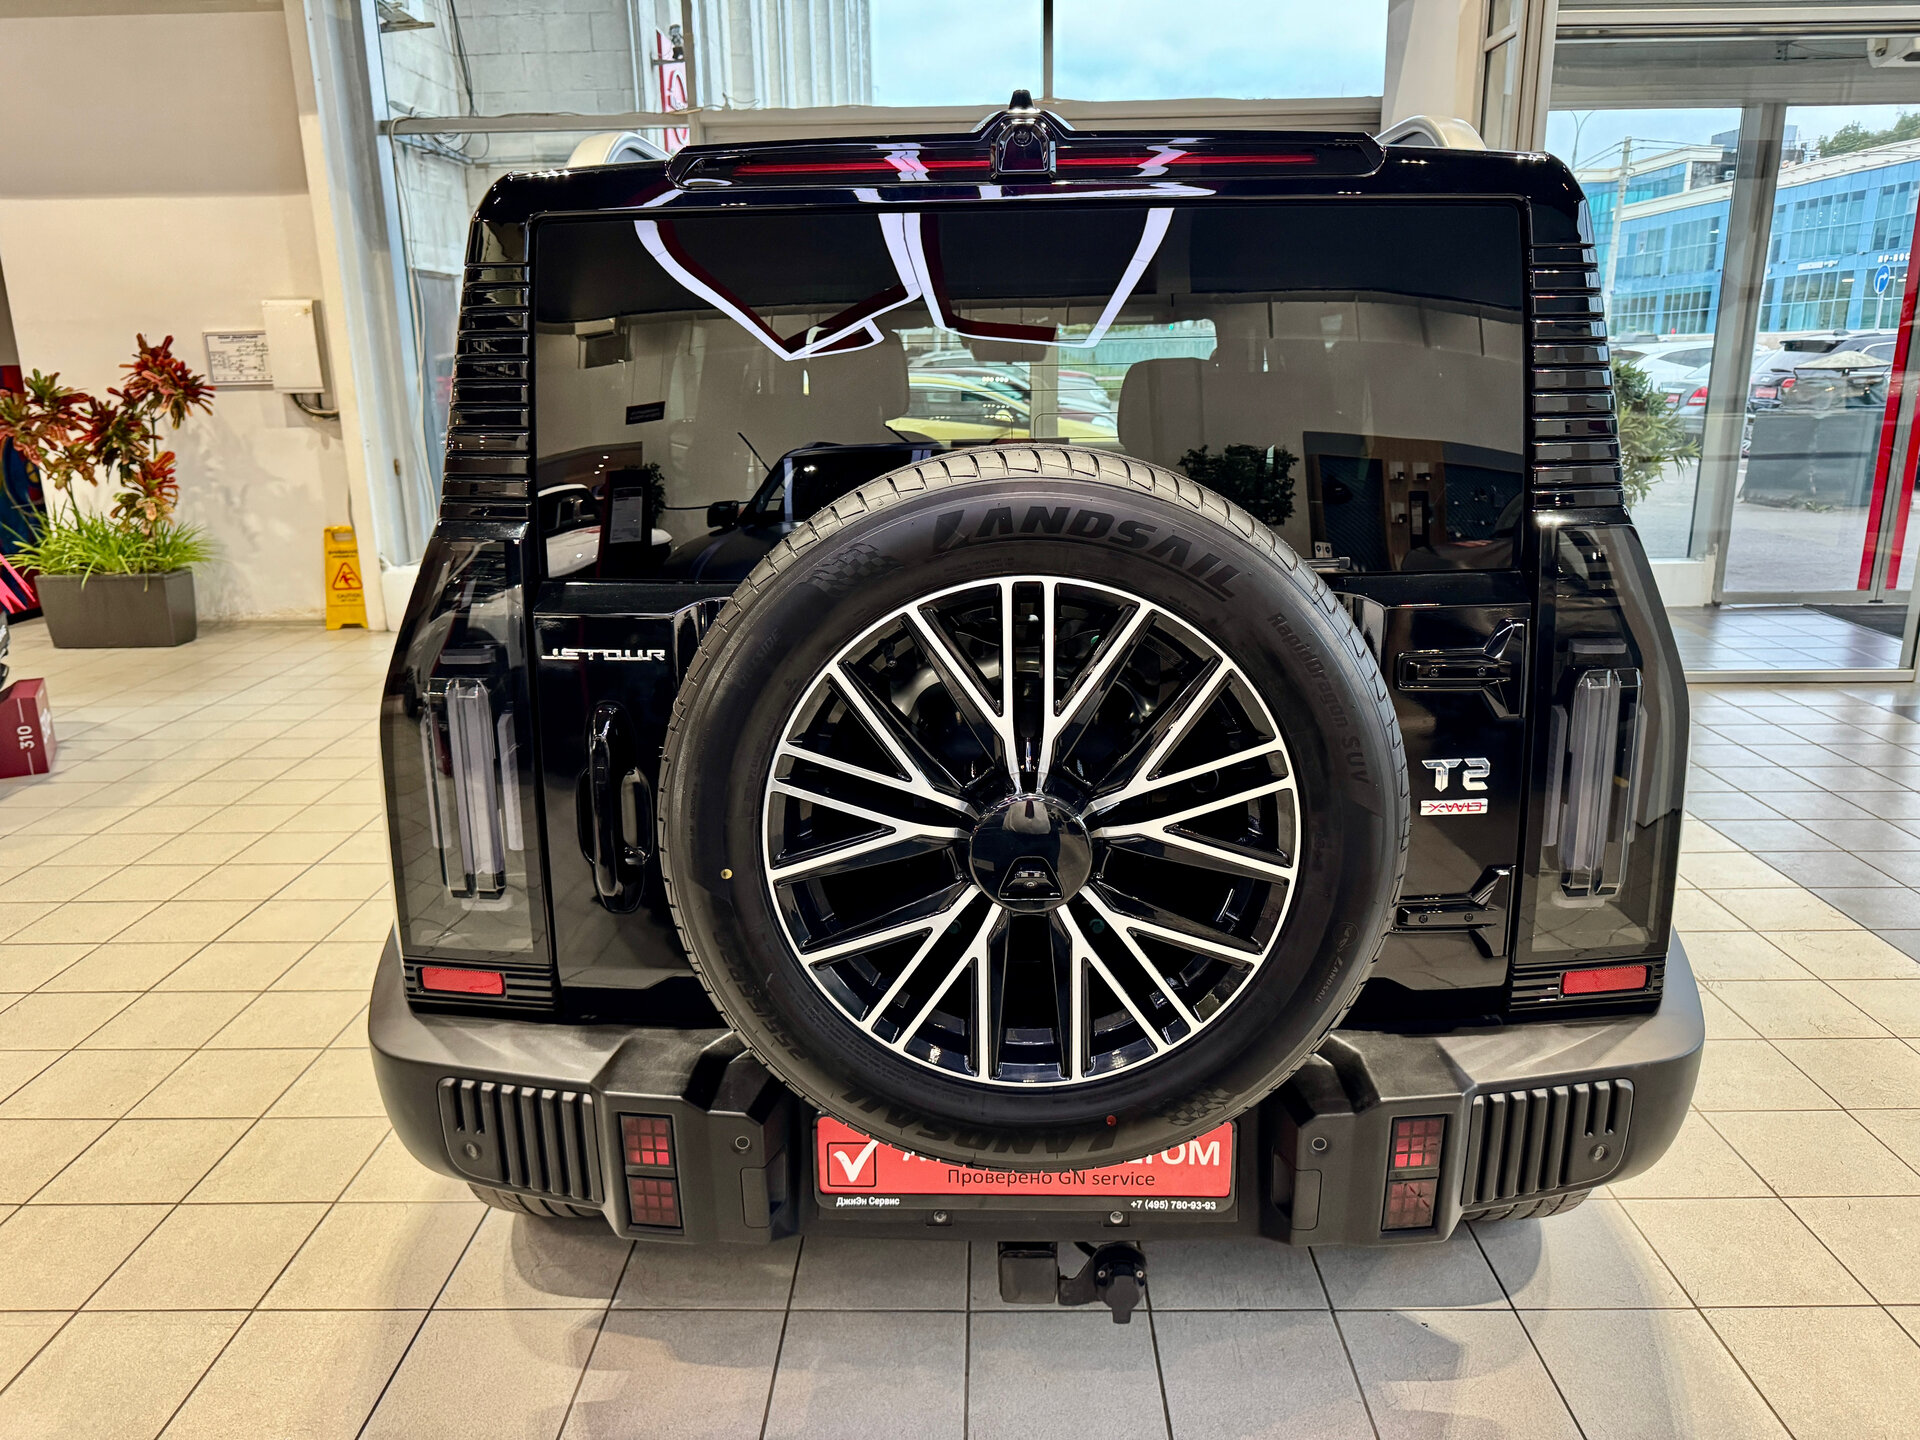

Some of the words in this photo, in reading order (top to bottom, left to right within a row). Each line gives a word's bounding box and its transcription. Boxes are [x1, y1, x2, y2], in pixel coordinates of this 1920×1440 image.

[932, 506, 1242, 599] LANDSAIL
[541, 648, 666, 661] JETOUR
[16, 725, 35, 750] 310
[1343, 735, 1370, 785] SUV
[1421, 757, 1491, 793] T2
[1425, 801, 1484, 814] XWD
[948, 1169, 1052, 1187] Проверено
[1058, 1171, 1086, 1185] GN
[1092, 1171, 1155, 1186] service
[836, 1196, 867, 1207] ДжиЭн
[868, 1196, 900, 1208] Сервис
[1130, 1200, 1143, 1209] +7
[1144, 1199, 1169, 1210] (495)
[1171, 1201, 1216, 1210] 780-93-93
